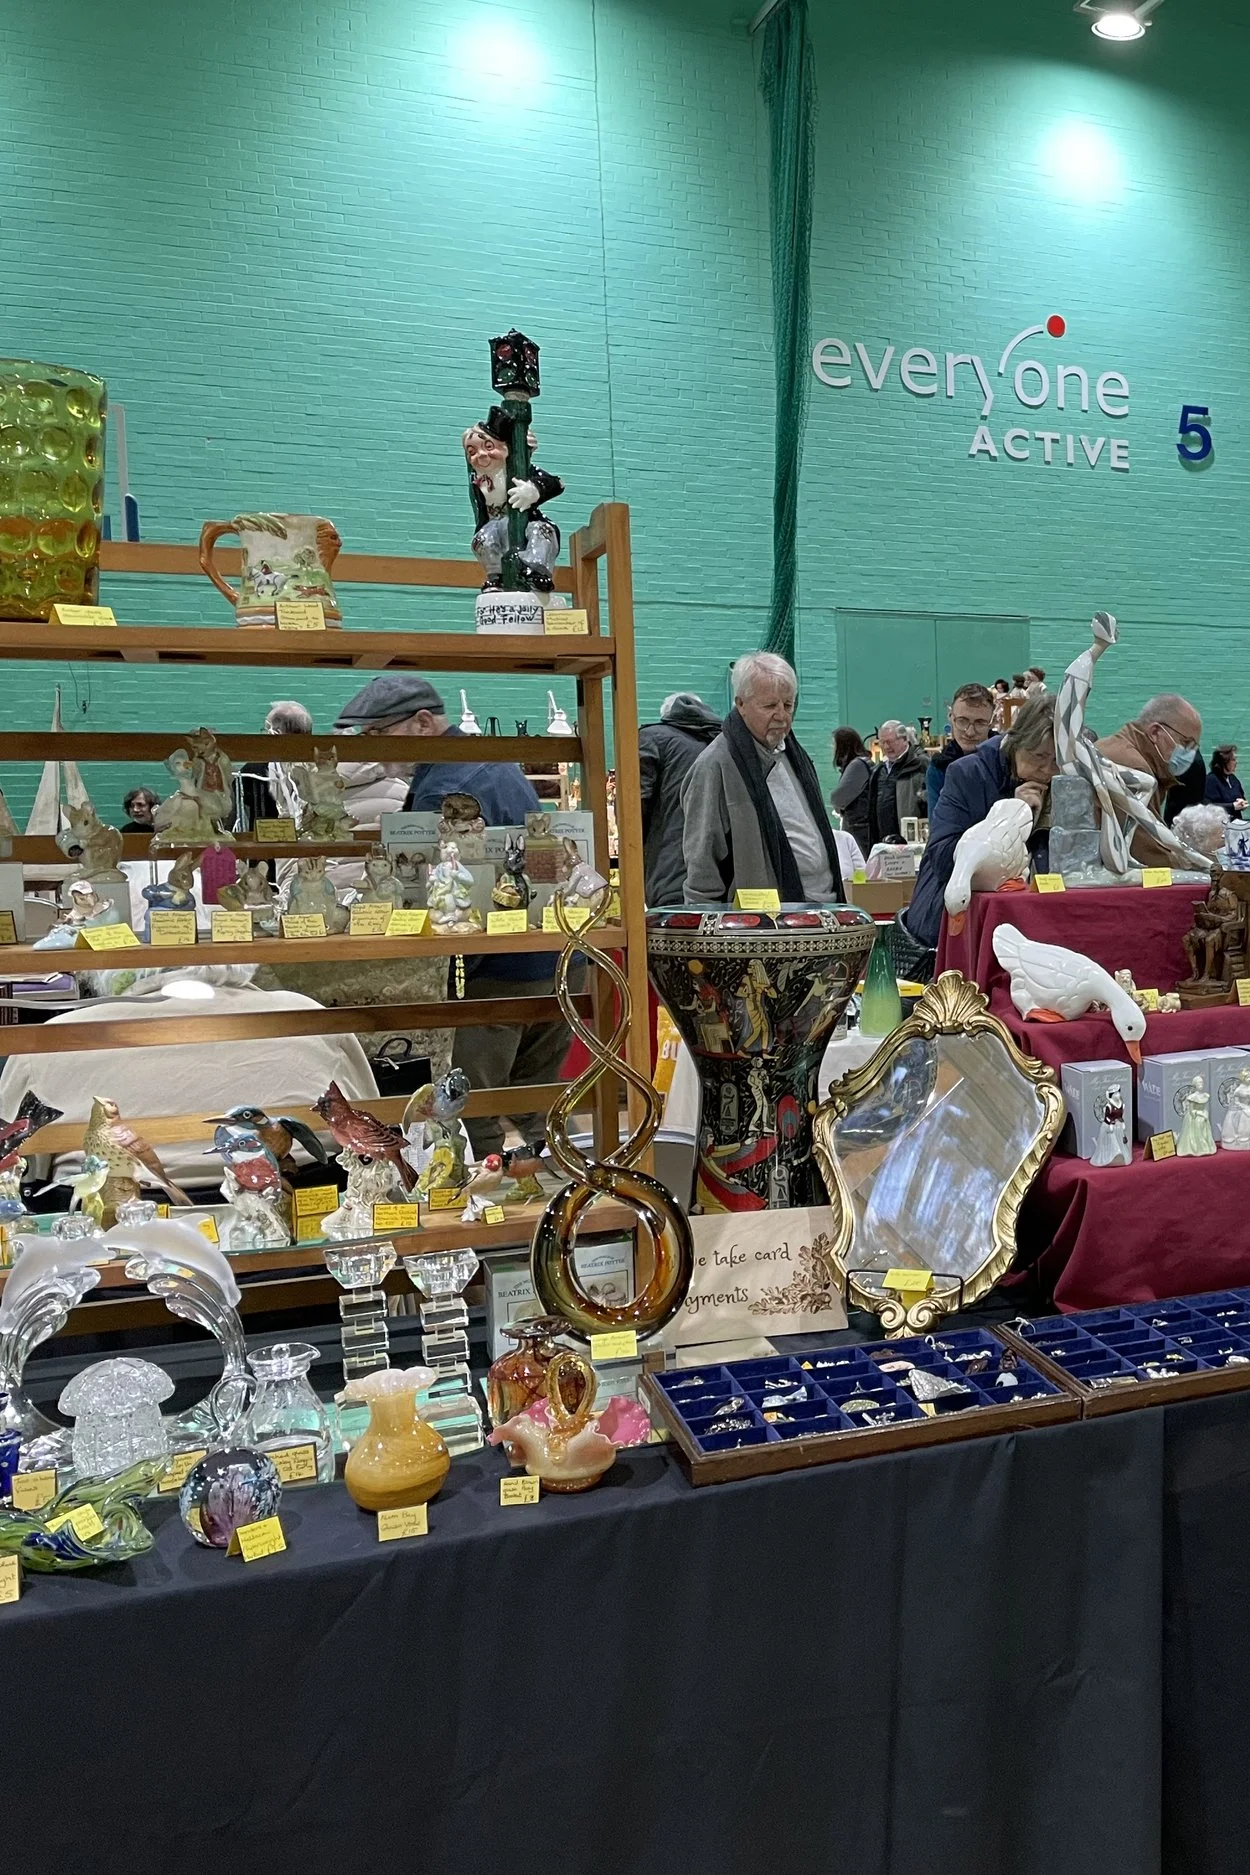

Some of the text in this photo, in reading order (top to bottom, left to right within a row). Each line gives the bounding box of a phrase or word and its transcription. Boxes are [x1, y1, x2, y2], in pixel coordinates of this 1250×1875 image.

[812, 324, 1130, 419] everyone
[1177, 404, 1213, 461] 5
[968, 426, 1130, 472] ACTIVE
[581, 1260, 604, 1269] BEATRIX
[713, 1244, 747, 1268] take
[754, 1242, 793, 1262] card
[497, 1288, 531, 1298] BEATRIX
[684, 1286, 749, 1314] ayments
